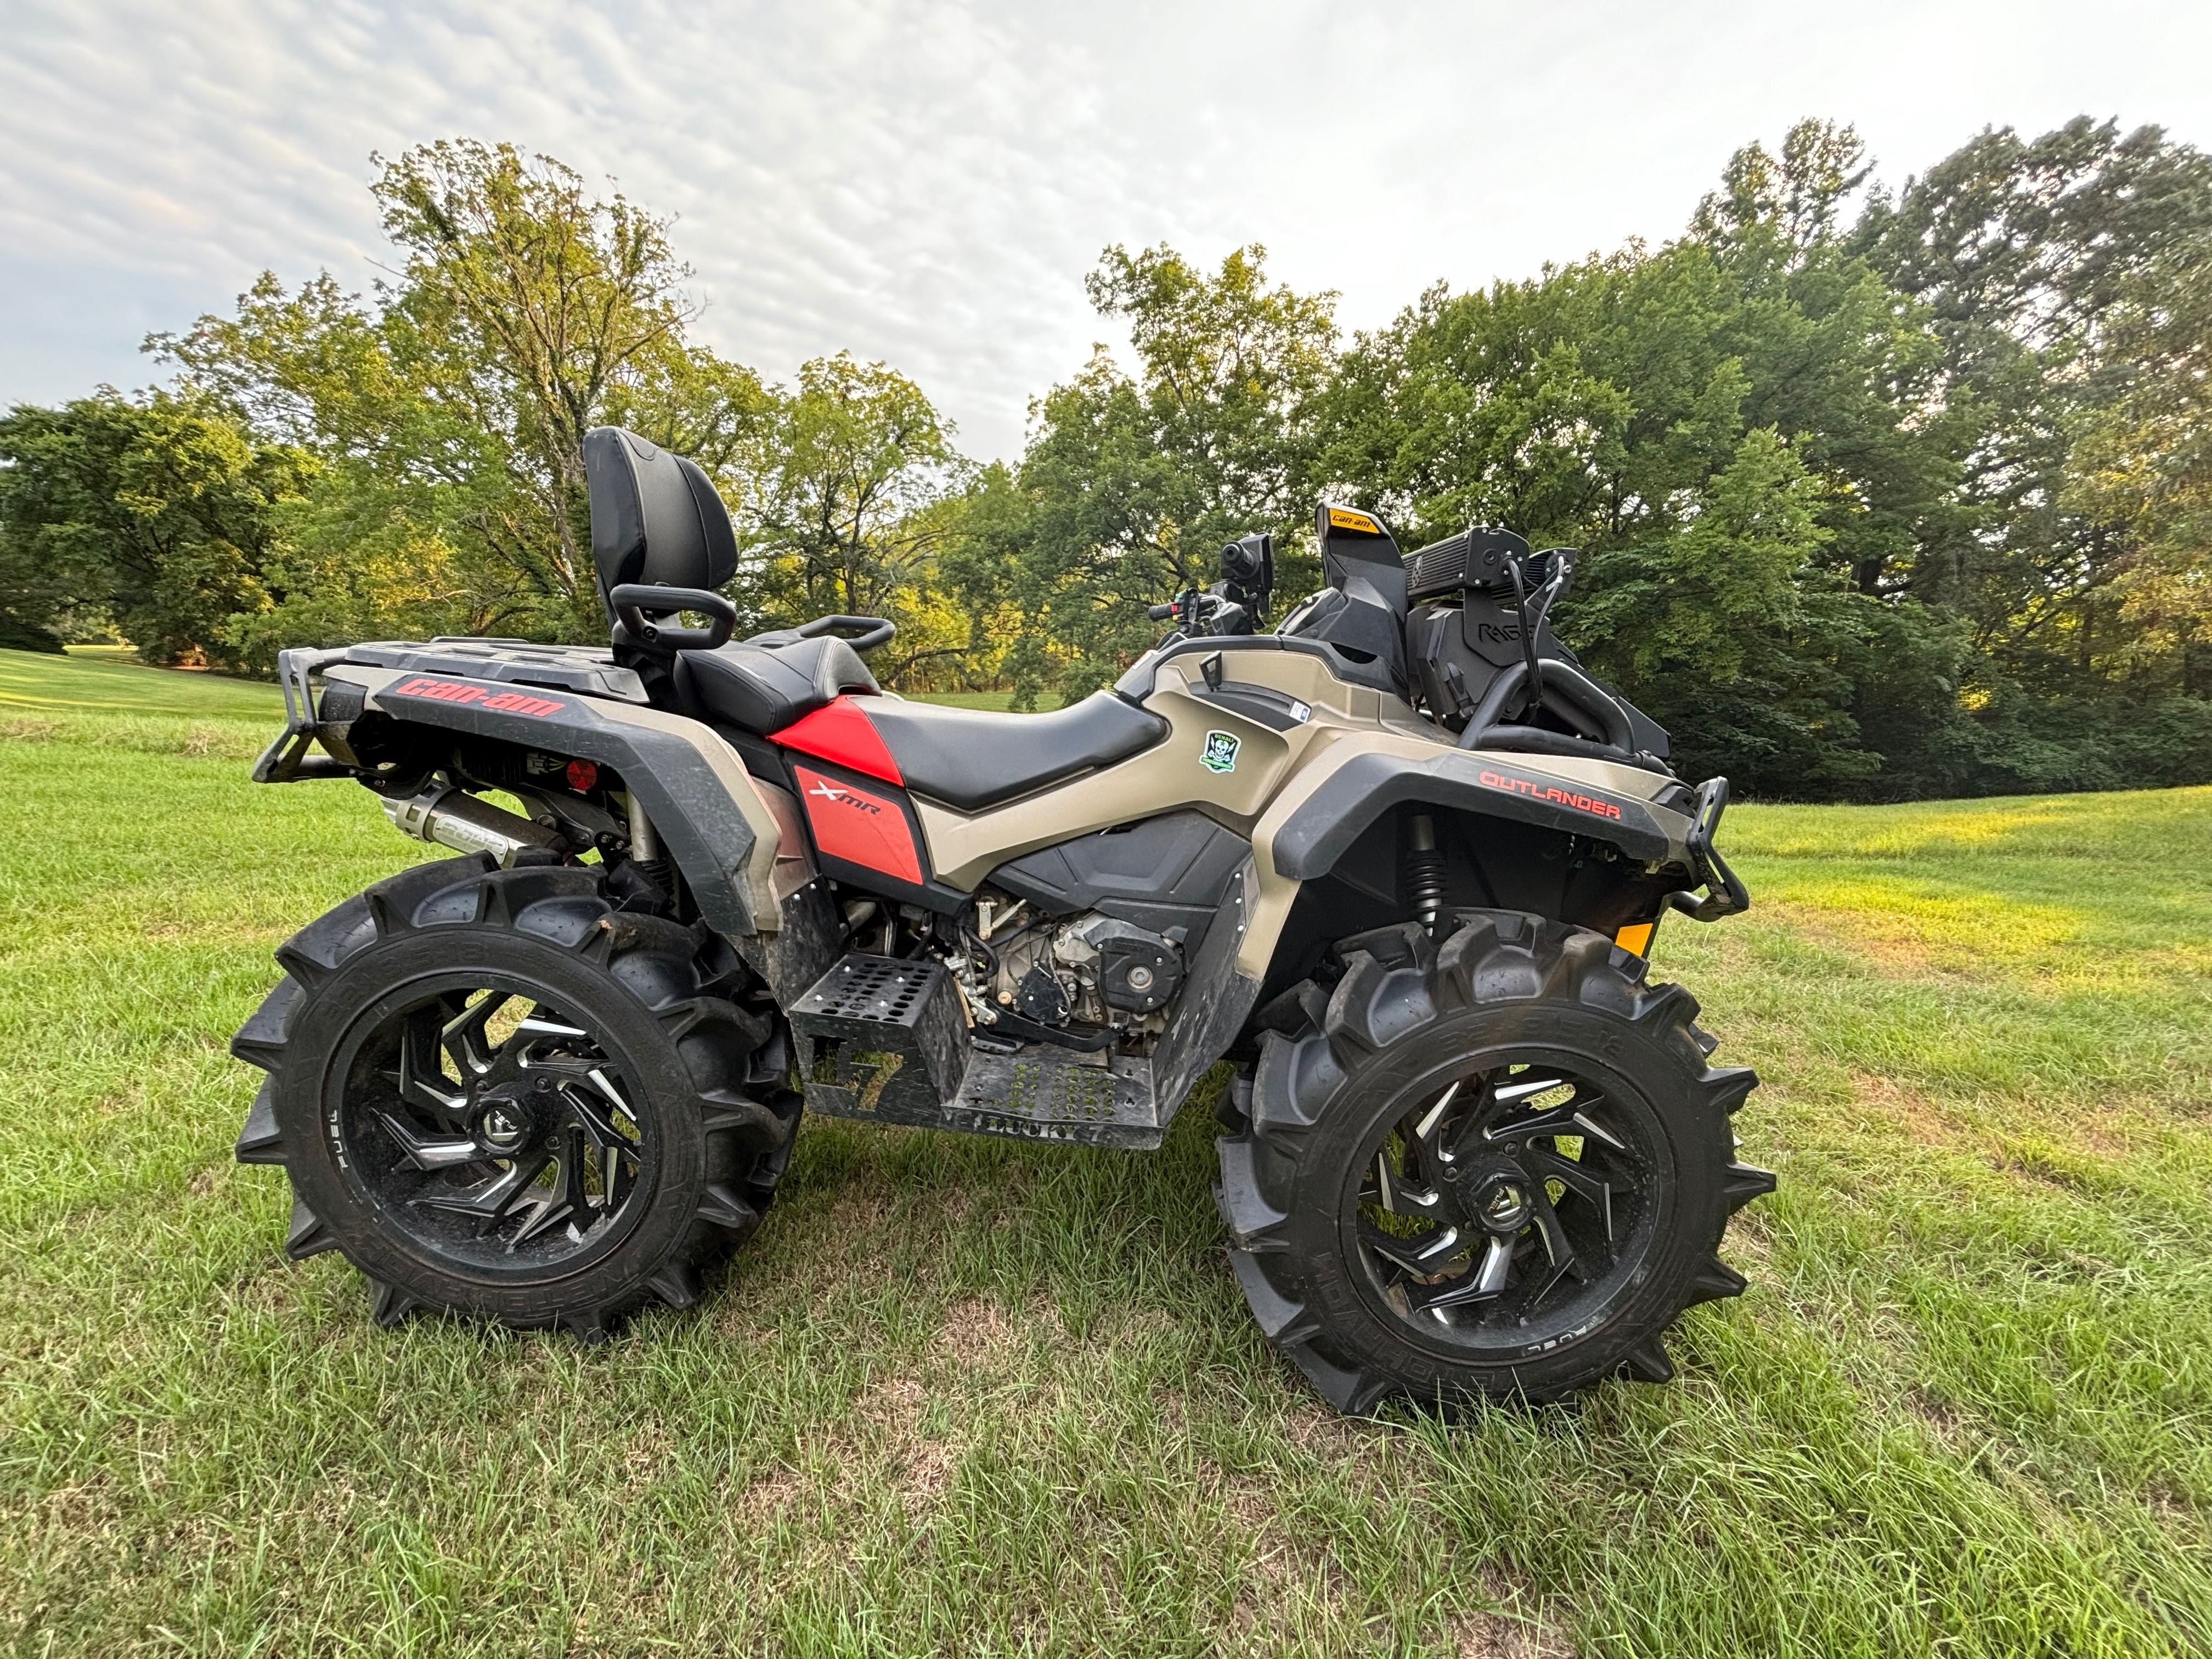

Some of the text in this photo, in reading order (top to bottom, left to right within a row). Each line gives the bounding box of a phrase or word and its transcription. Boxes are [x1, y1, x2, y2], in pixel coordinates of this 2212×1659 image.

[1332, 514, 1371, 528] can-am
[396, 678, 565, 717] can-am
[1214, 733, 1234, 743] DENALI
[1480, 771, 1621, 820] OUTLANDER
[329, 1109, 349, 1169] FUEL
